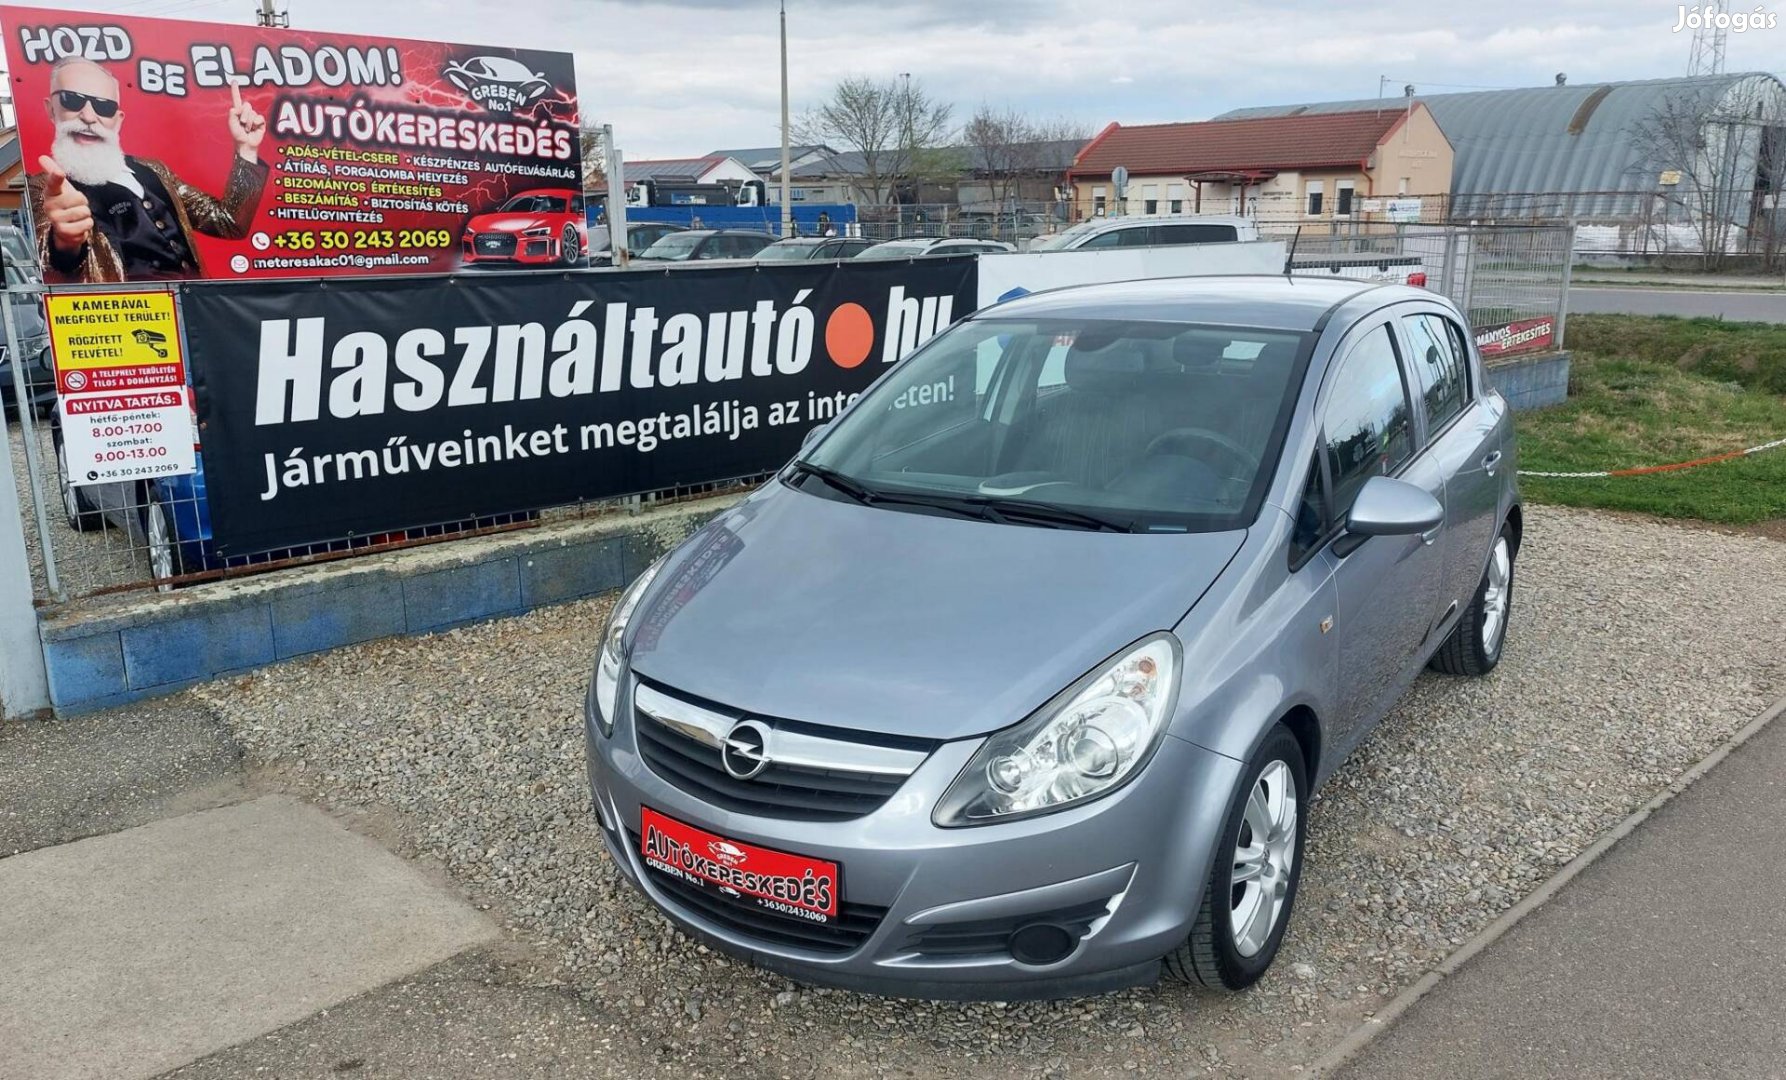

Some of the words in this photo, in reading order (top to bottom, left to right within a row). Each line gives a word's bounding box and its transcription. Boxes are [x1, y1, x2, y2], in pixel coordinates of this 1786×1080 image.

[21, 26, 131, 62] HOZD
[140, 60, 186, 96] BE
[191, 45, 402, 86] ELADOM!
[471, 85, 527, 106] GREBEN
[488, 100, 512, 112] No.1
[277, 100, 571, 160] AUTÓKERESKEDÉS
[286, 145, 399, 164] ADÁS-VÉTEL-CSERE
[413, 155, 481, 171] KÉSZPÉNZES
[485, 162, 575, 179] AUTÓFELVÁSÁRLÁS
[284, 160, 331, 176] ÁTÍRÁS,
[335, 165, 415, 180] FORGALOMBA
[417, 172, 468, 185] HELYEZÉS
[283, 177, 366, 193] BIZOMÁNYOS
[371, 181, 442, 197] ÉRTÉKESÍTÉS
[284, 192, 359, 207] BESZÁMÍTÁS
[371, 198, 433, 212] BIZTOSÍTÁS
[436, 200, 469, 214] KÖTÉS
[274, 231, 315, 250] +36
[320, 231, 349, 249] 30
[354, 230, 394, 249] 243
[398, 230, 451, 248] 2069
[72, 297, 151, 311] KAMERÁVAL
[55, 314, 119, 325] MEGFIGYELT
[125, 311, 171, 322] TERÜLET!
[68, 333, 122, 346] RÖGZÍTETT
[1474, 325, 1511, 347] MÁNYOS
[71, 347, 123, 359] FELVÉTEL!
[255, 288, 815, 426] Használtautó
[93, 379, 117, 387] TILOS
[119, 378, 125, 386] A
[127, 375, 177, 385] DOHÁNYZÁS!
[100, 369, 137, 377] TELEPHELY
[72, 399, 123, 412] NYITVA
[125, 393, 176, 408] TARTÁS:
[92, 422, 163, 438] 8.00-17.00
[107, 437, 153, 448] szombat:
[261, 423, 568, 501] Járműveinket
[580, 399, 759, 452] megtalálja
[768, 400, 800, 426] az
[94, 446, 167, 462] 9.00-13.00
[100, 470, 117, 478] +36
[120, 468, 132, 477] 30
[135, 466, 153, 475] 243
[155, 463, 179, 472] 2069
[646, 825, 832, 911] AUTÓKERESKEDÉS
[646, 857, 684, 878] GREBEN
[685, 872, 705, 887] No.1
[757, 897, 827, 923] +3630/2432069
